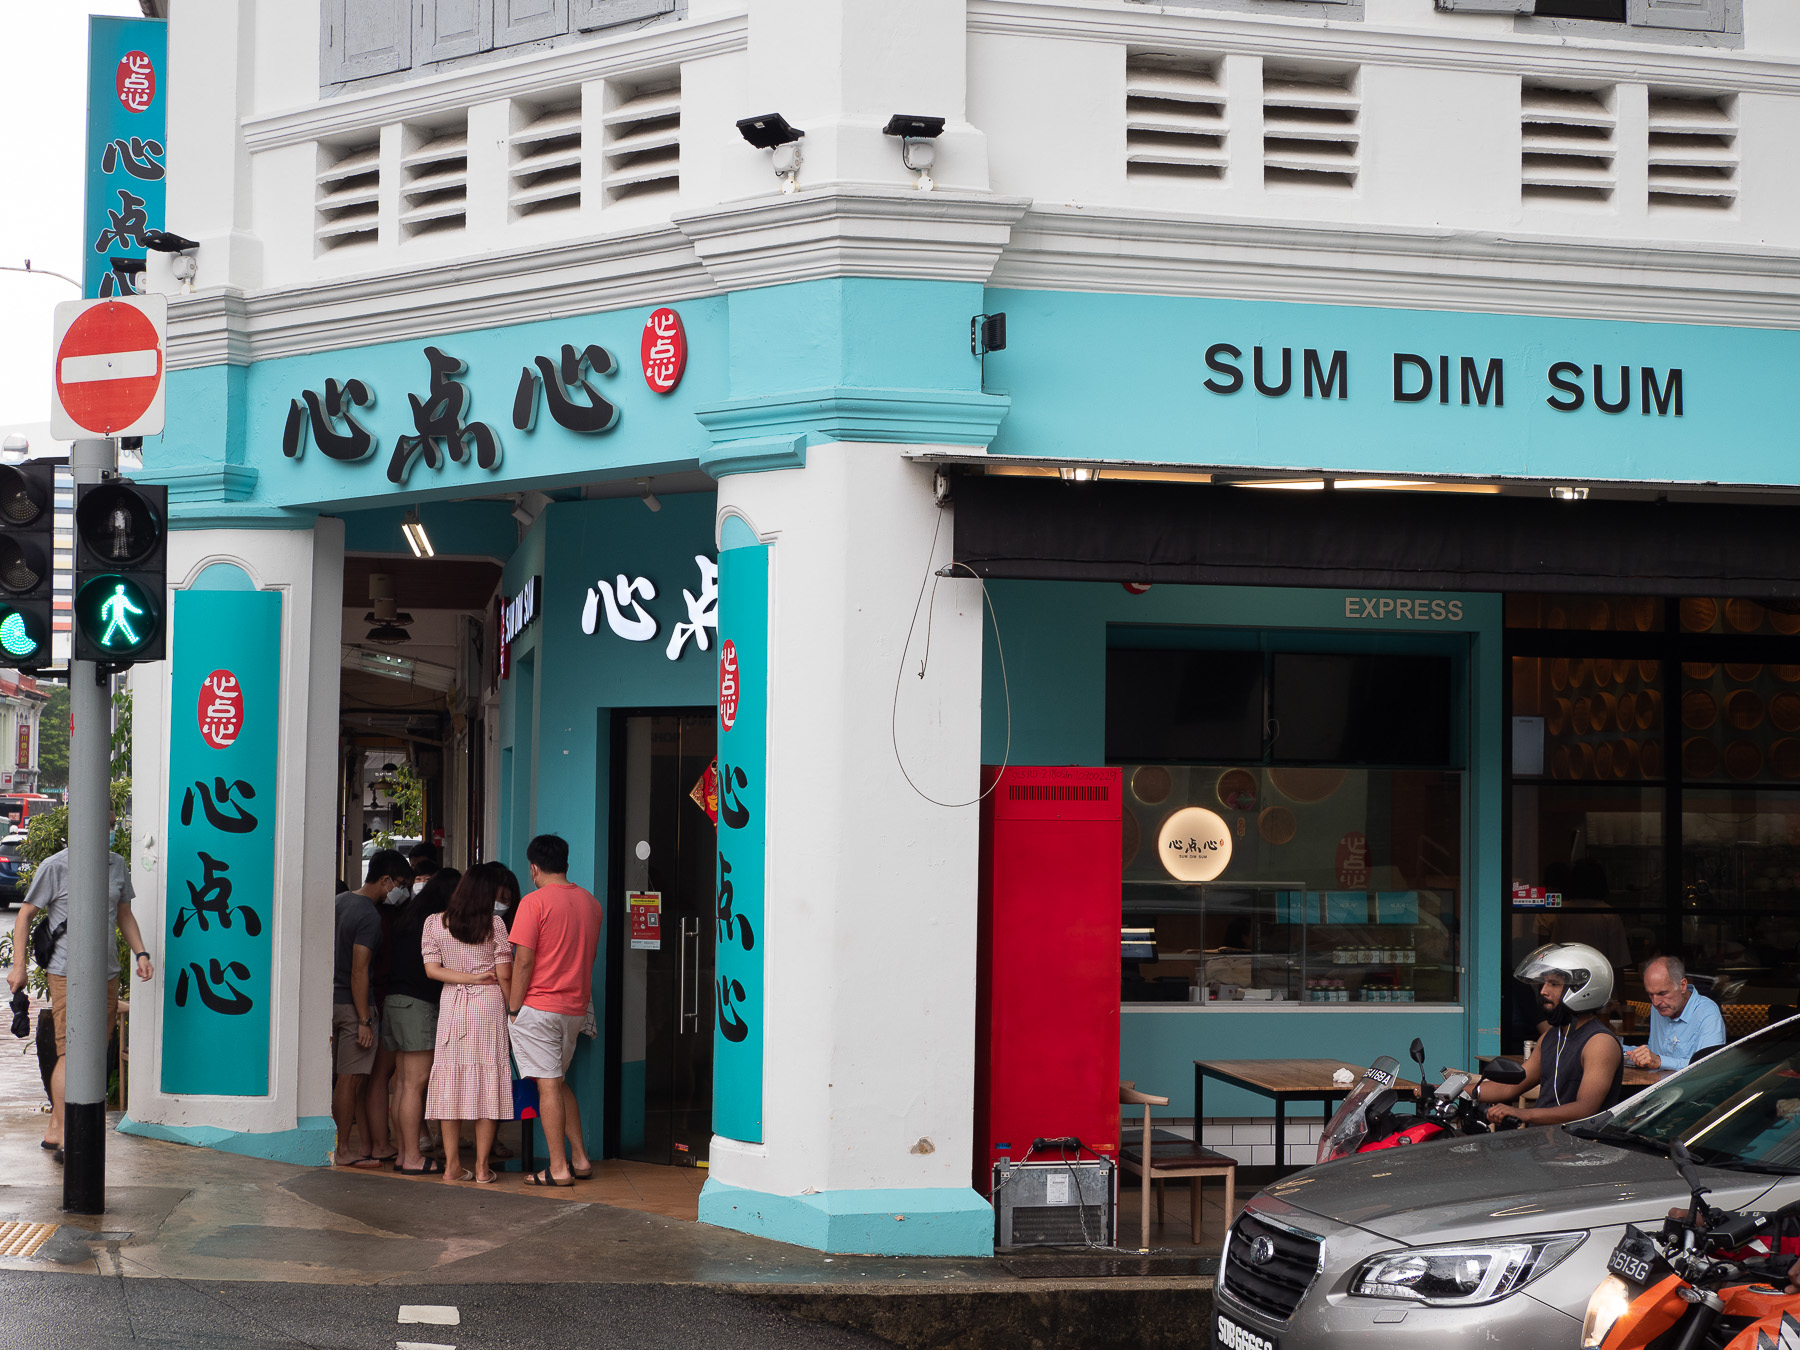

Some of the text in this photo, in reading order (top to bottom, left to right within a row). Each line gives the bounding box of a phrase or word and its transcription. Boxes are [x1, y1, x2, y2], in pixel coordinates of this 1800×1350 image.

[283, 345, 619, 484] 心点心
[1203, 342, 1684, 417] SUM DIM SUM
[1345, 597, 1463, 621] EXPRESS
[1168, 837, 1218, 854] 心点心
[172, 776, 262, 1016] 心点心
